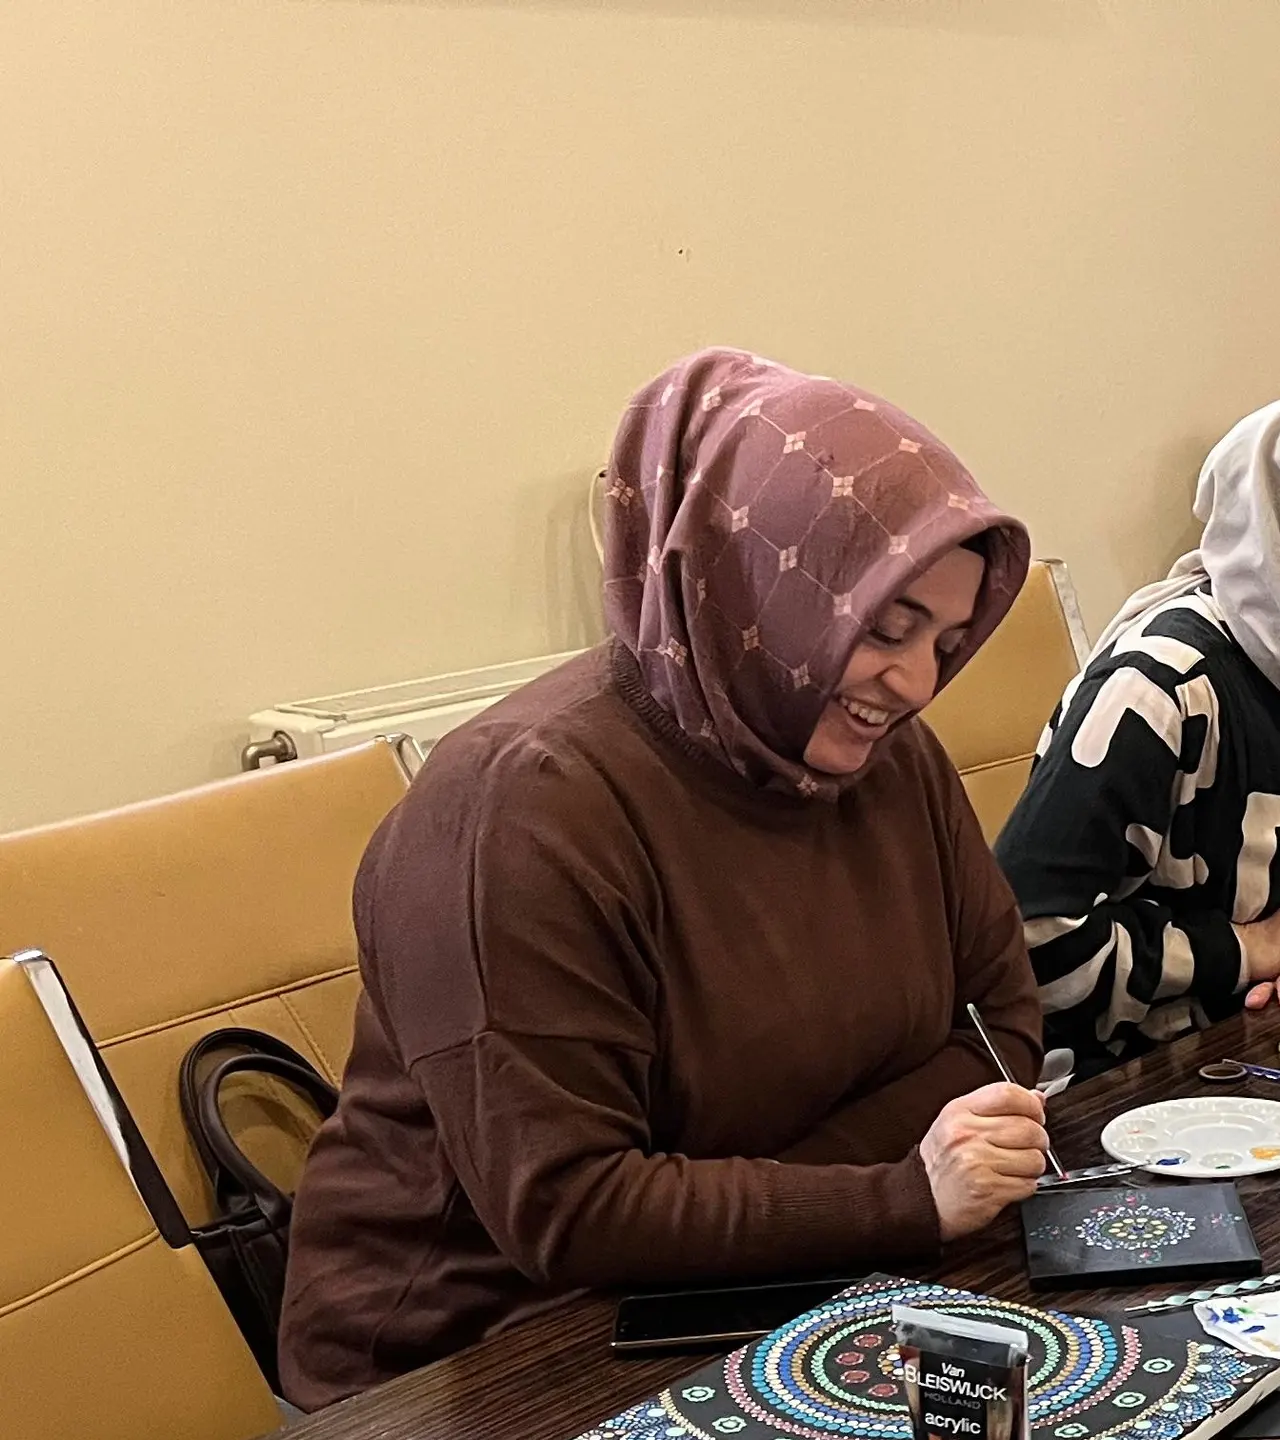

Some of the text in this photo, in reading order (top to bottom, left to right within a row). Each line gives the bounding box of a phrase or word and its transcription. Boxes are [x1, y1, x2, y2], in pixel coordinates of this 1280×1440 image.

[941, 1362, 965, 1378] Van
[905, 1364, 1007, 1402] BLEISWIJCK
[924, 1391, 981, 1410] HOLLAND
[925, 1412, 981, 1435] acrylic
